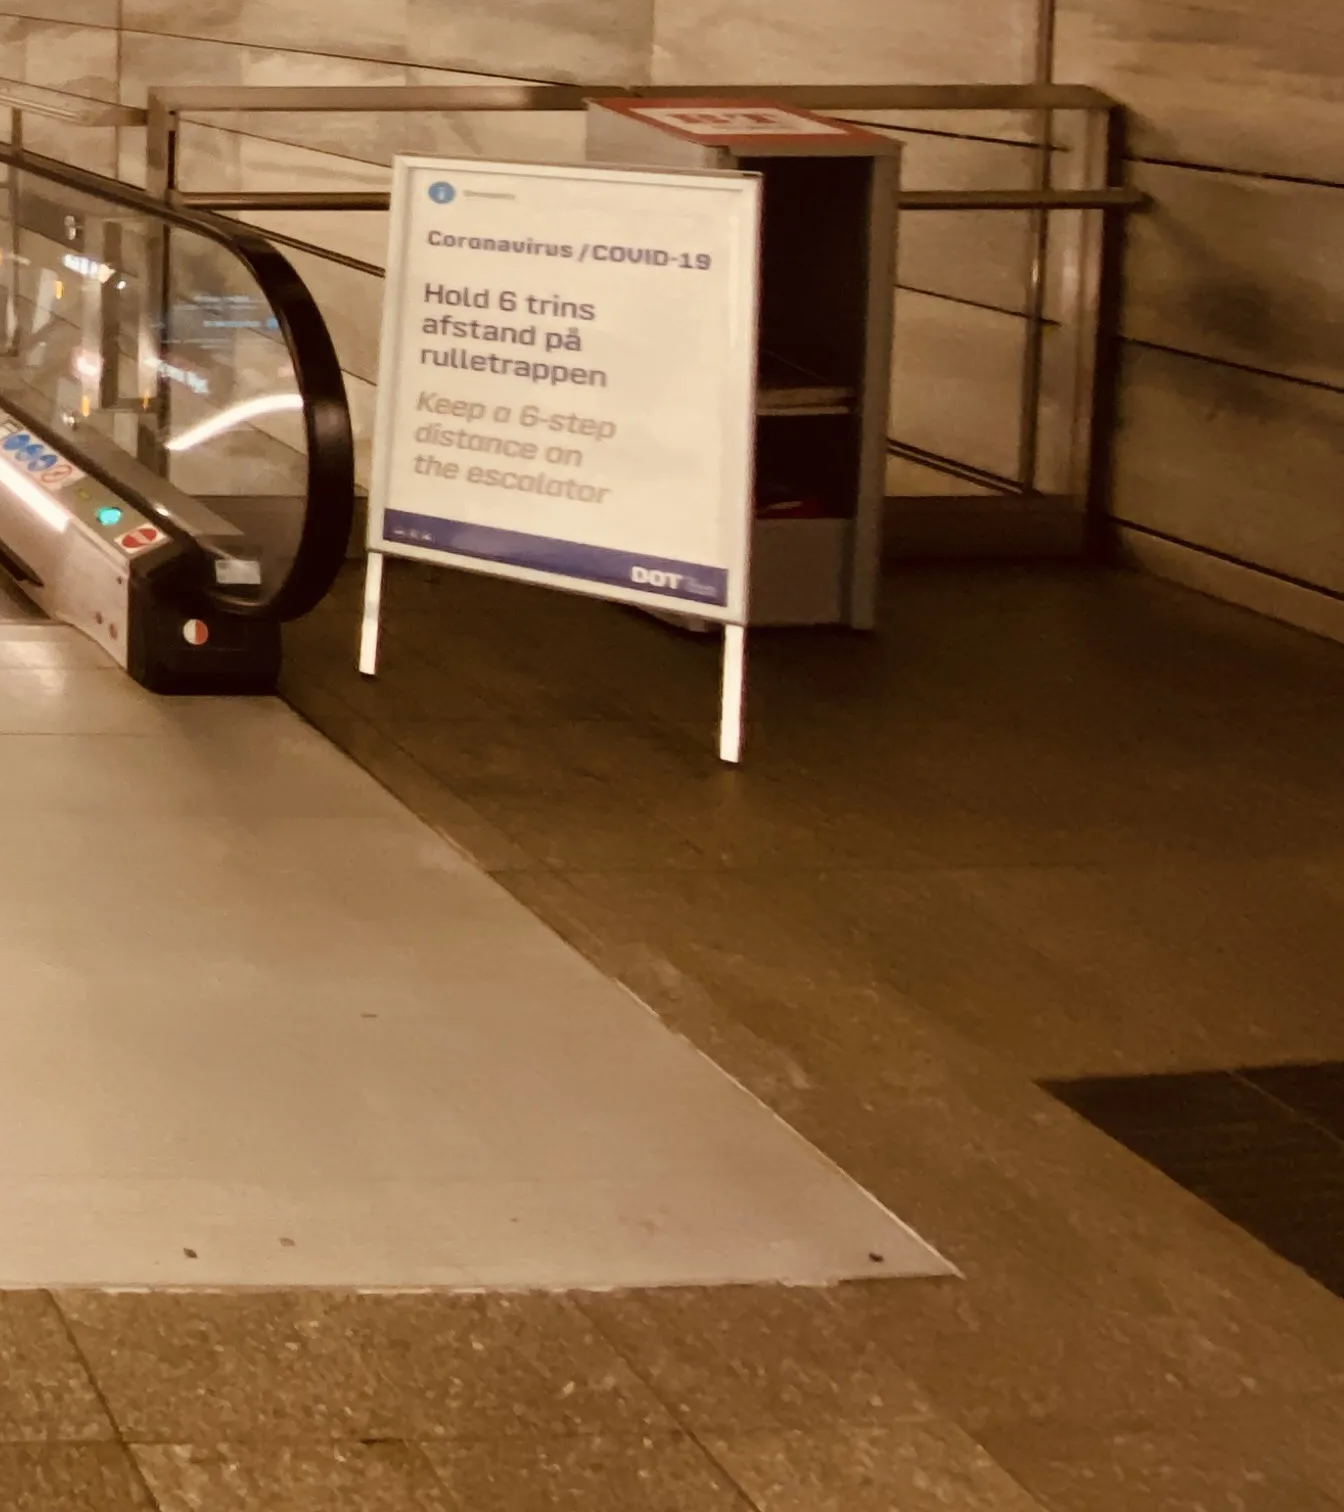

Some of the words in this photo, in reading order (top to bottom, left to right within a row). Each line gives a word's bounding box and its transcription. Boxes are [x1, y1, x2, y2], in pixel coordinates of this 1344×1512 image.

[427, 229, 573, 258] Coronavirus
[424, 282, 490, 309] Hold
[499, 290, 517, 312] 6
[526, 294, 596, 321] trins
[422, 315, 537, 346] afstand
[545, 326, 582, 352] på
[420, 347, 608, 387] rulletrappen
[416, 391, 487, 422] Keep
[493, 405, 512, 423] a
[519, 404, 617, 441] 6-step
[415, 423, 538, 460] distance
[545, 445, 583, 467] on
[413, 453, 460, 479] the
[466, 464, 613, 503] escalator
[631, 566, 684, 589] DOT
